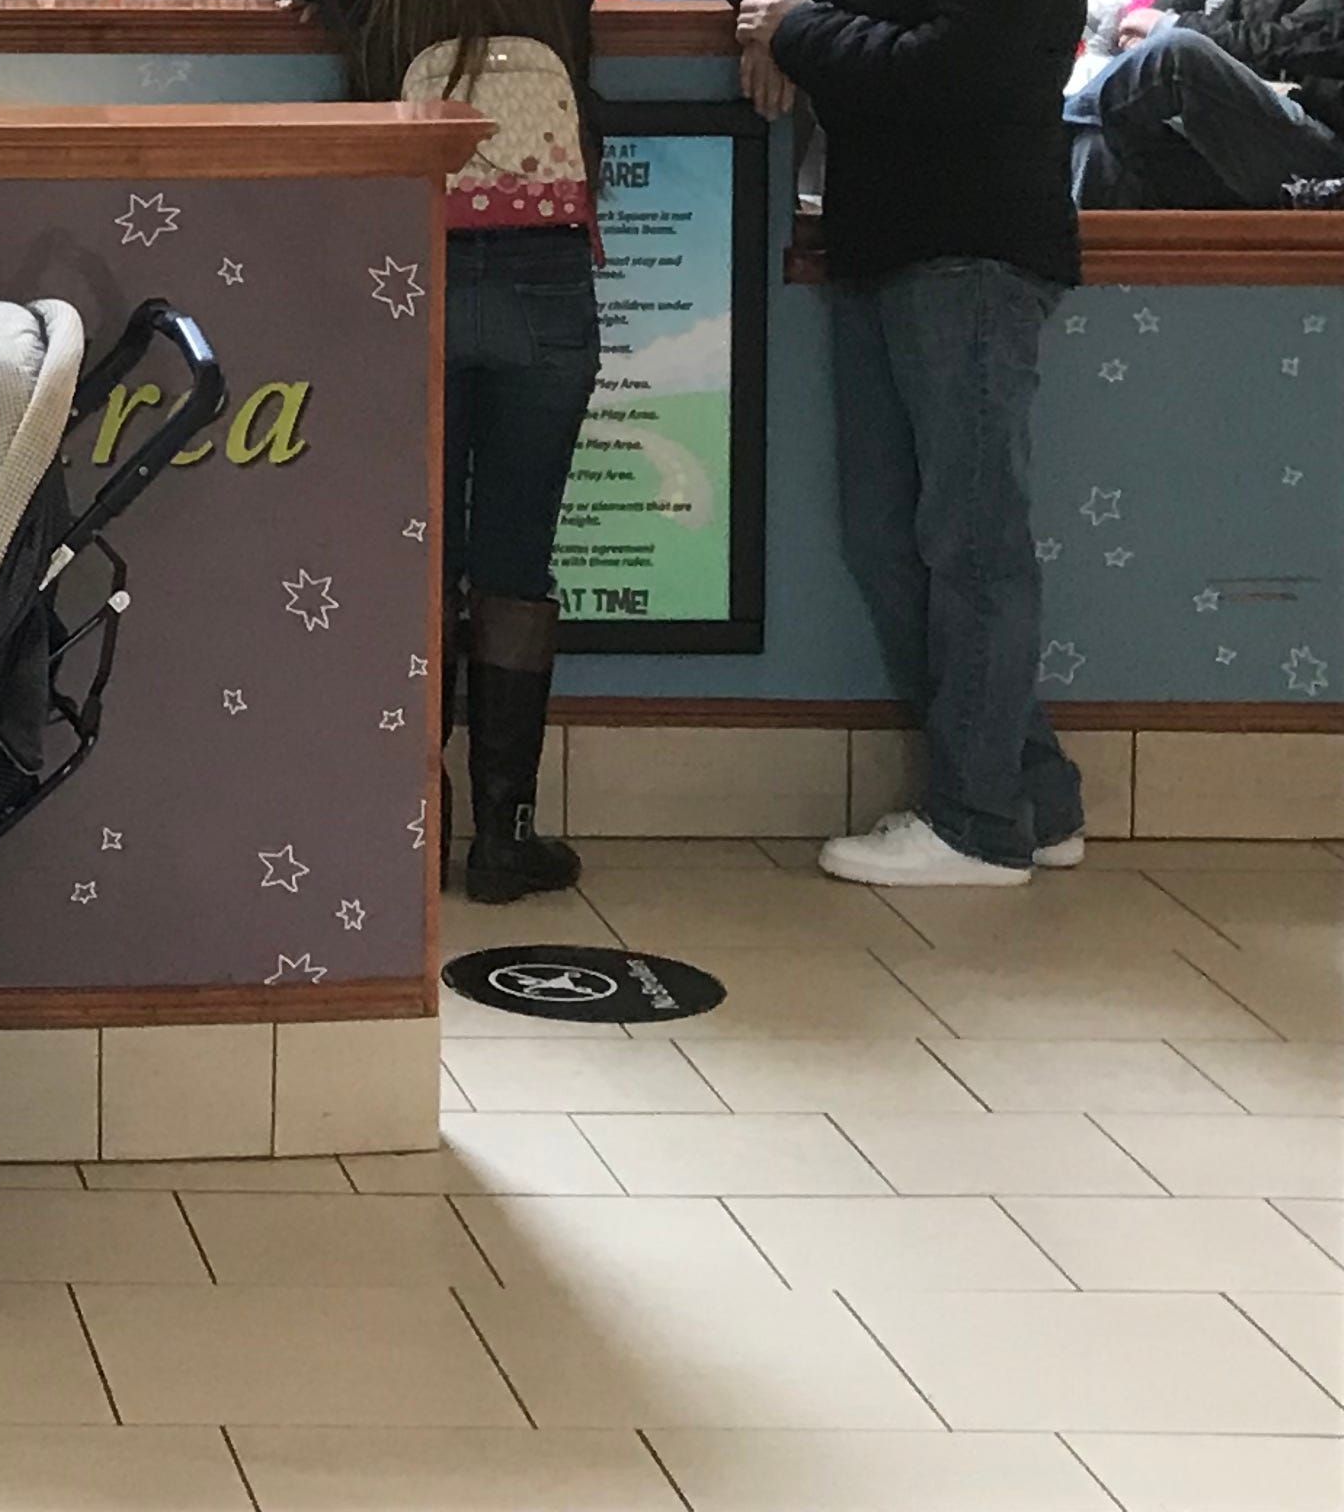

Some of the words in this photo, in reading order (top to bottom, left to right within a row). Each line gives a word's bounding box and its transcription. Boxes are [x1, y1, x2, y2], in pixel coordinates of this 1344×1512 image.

[619, 144, 637, 158] AT
[600, 161, 650, 188] ARE!
[672, 212, 692, 221] not
[608, 299, 655, 311] children
[658, 300, 693, 311] under
[560, 587, 587, 613] AT
[592, 587, 649, 615] TIME!
